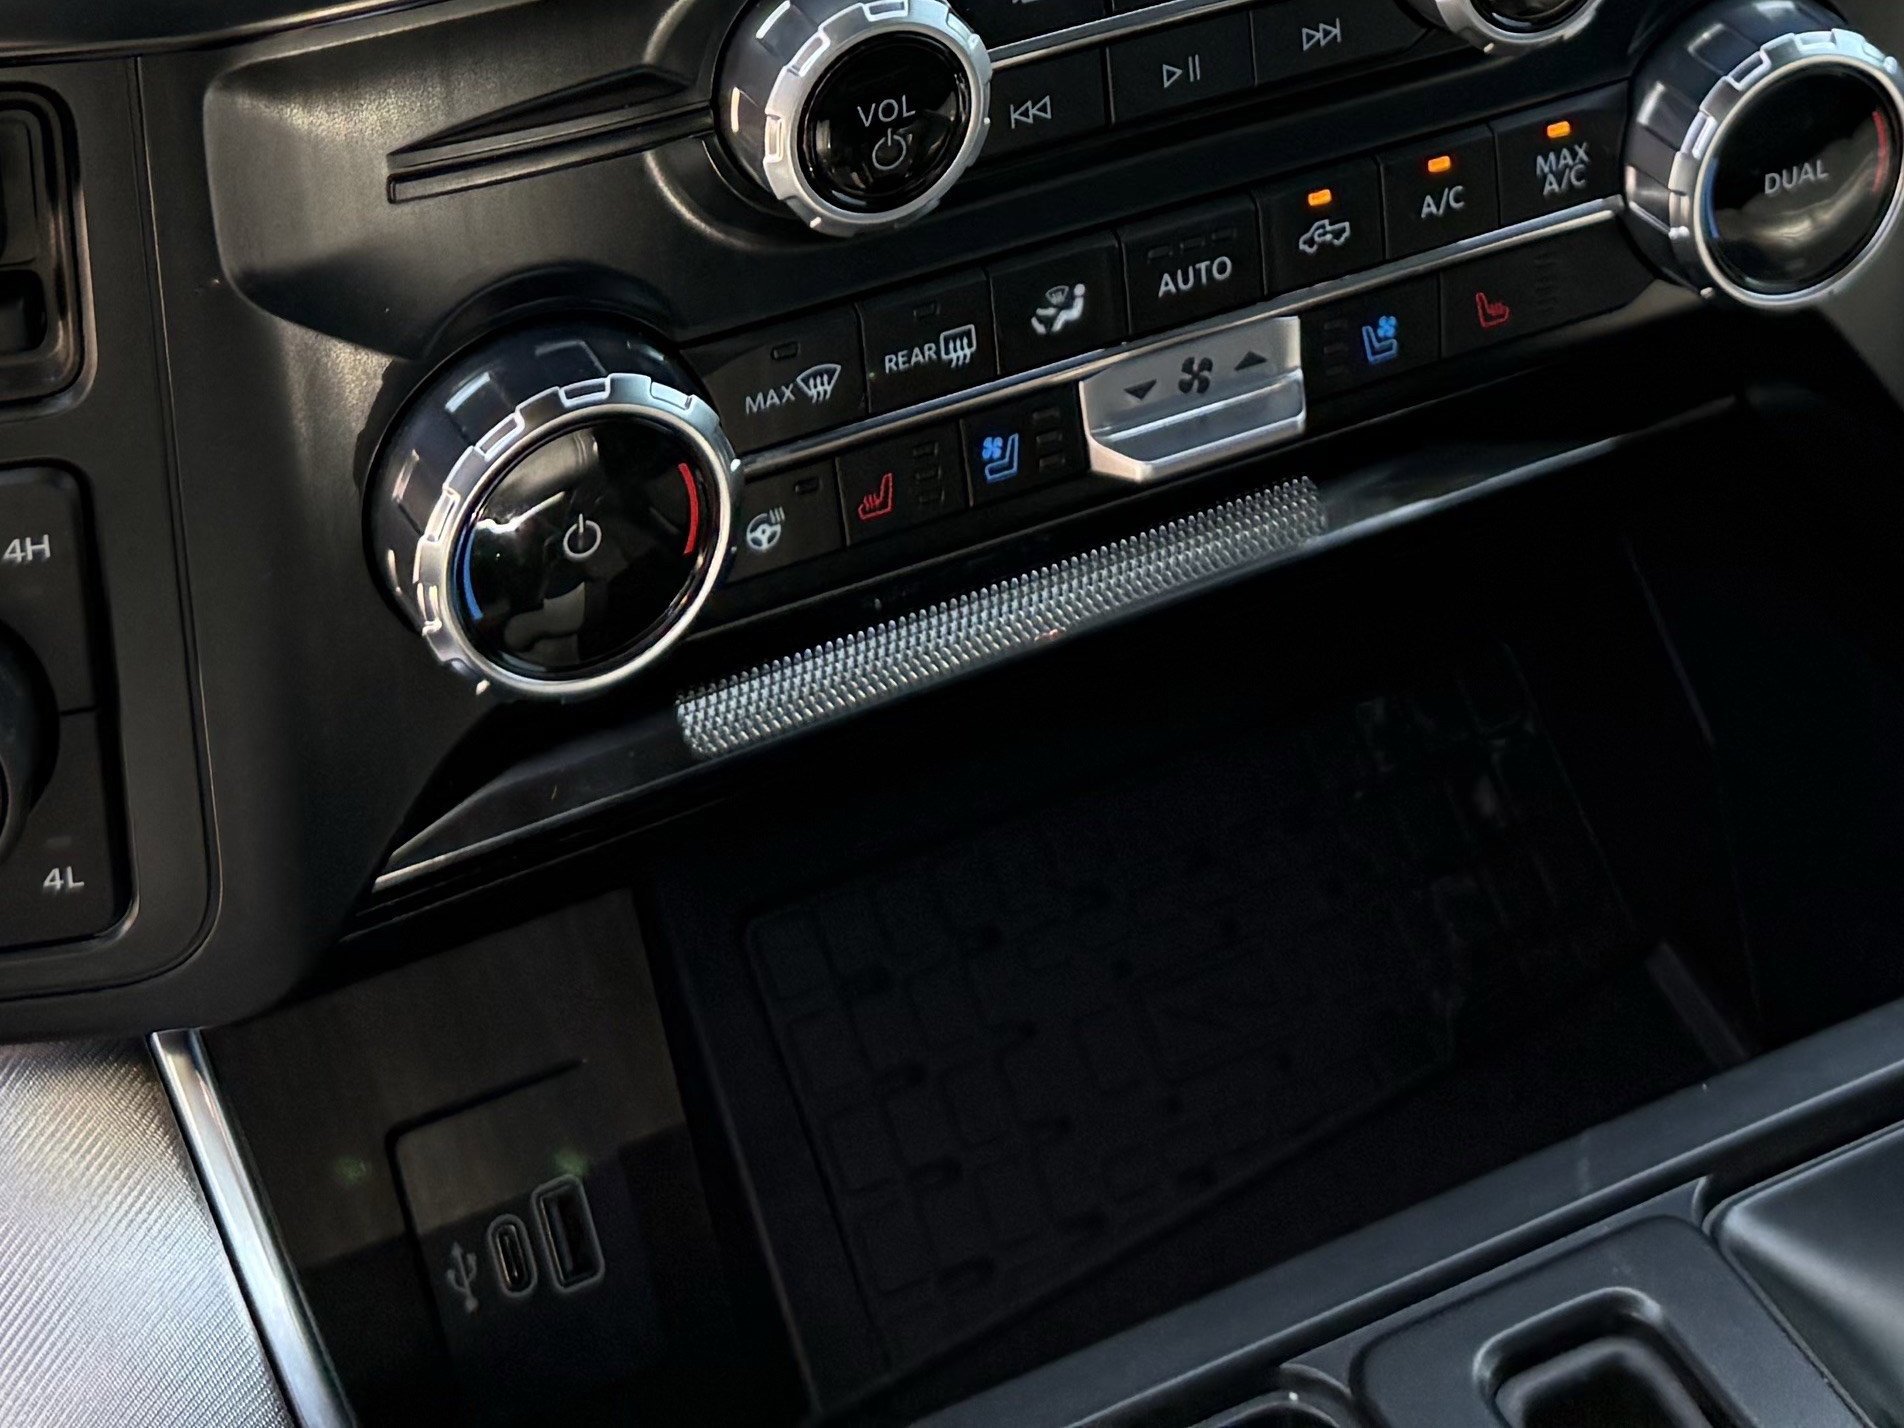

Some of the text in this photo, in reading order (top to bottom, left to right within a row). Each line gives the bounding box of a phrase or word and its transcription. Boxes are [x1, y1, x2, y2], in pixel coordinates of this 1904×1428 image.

[856, 94, 916, 127] VOL
[1536, 142, 1590, 178] MAX
[1542, 164, 1587, 196] A/C
[1764, 159, 1829, 195] DUAL
[1420, 185, 1465, 219] A/C
[1158, 256, 1232, 298] AUTO
[884, 342, 937, 374] REAR
[744, 383, 796, 416] MAX
[3, 534, 51, 563] 4H
[43, 866, 85, 890] 4L
